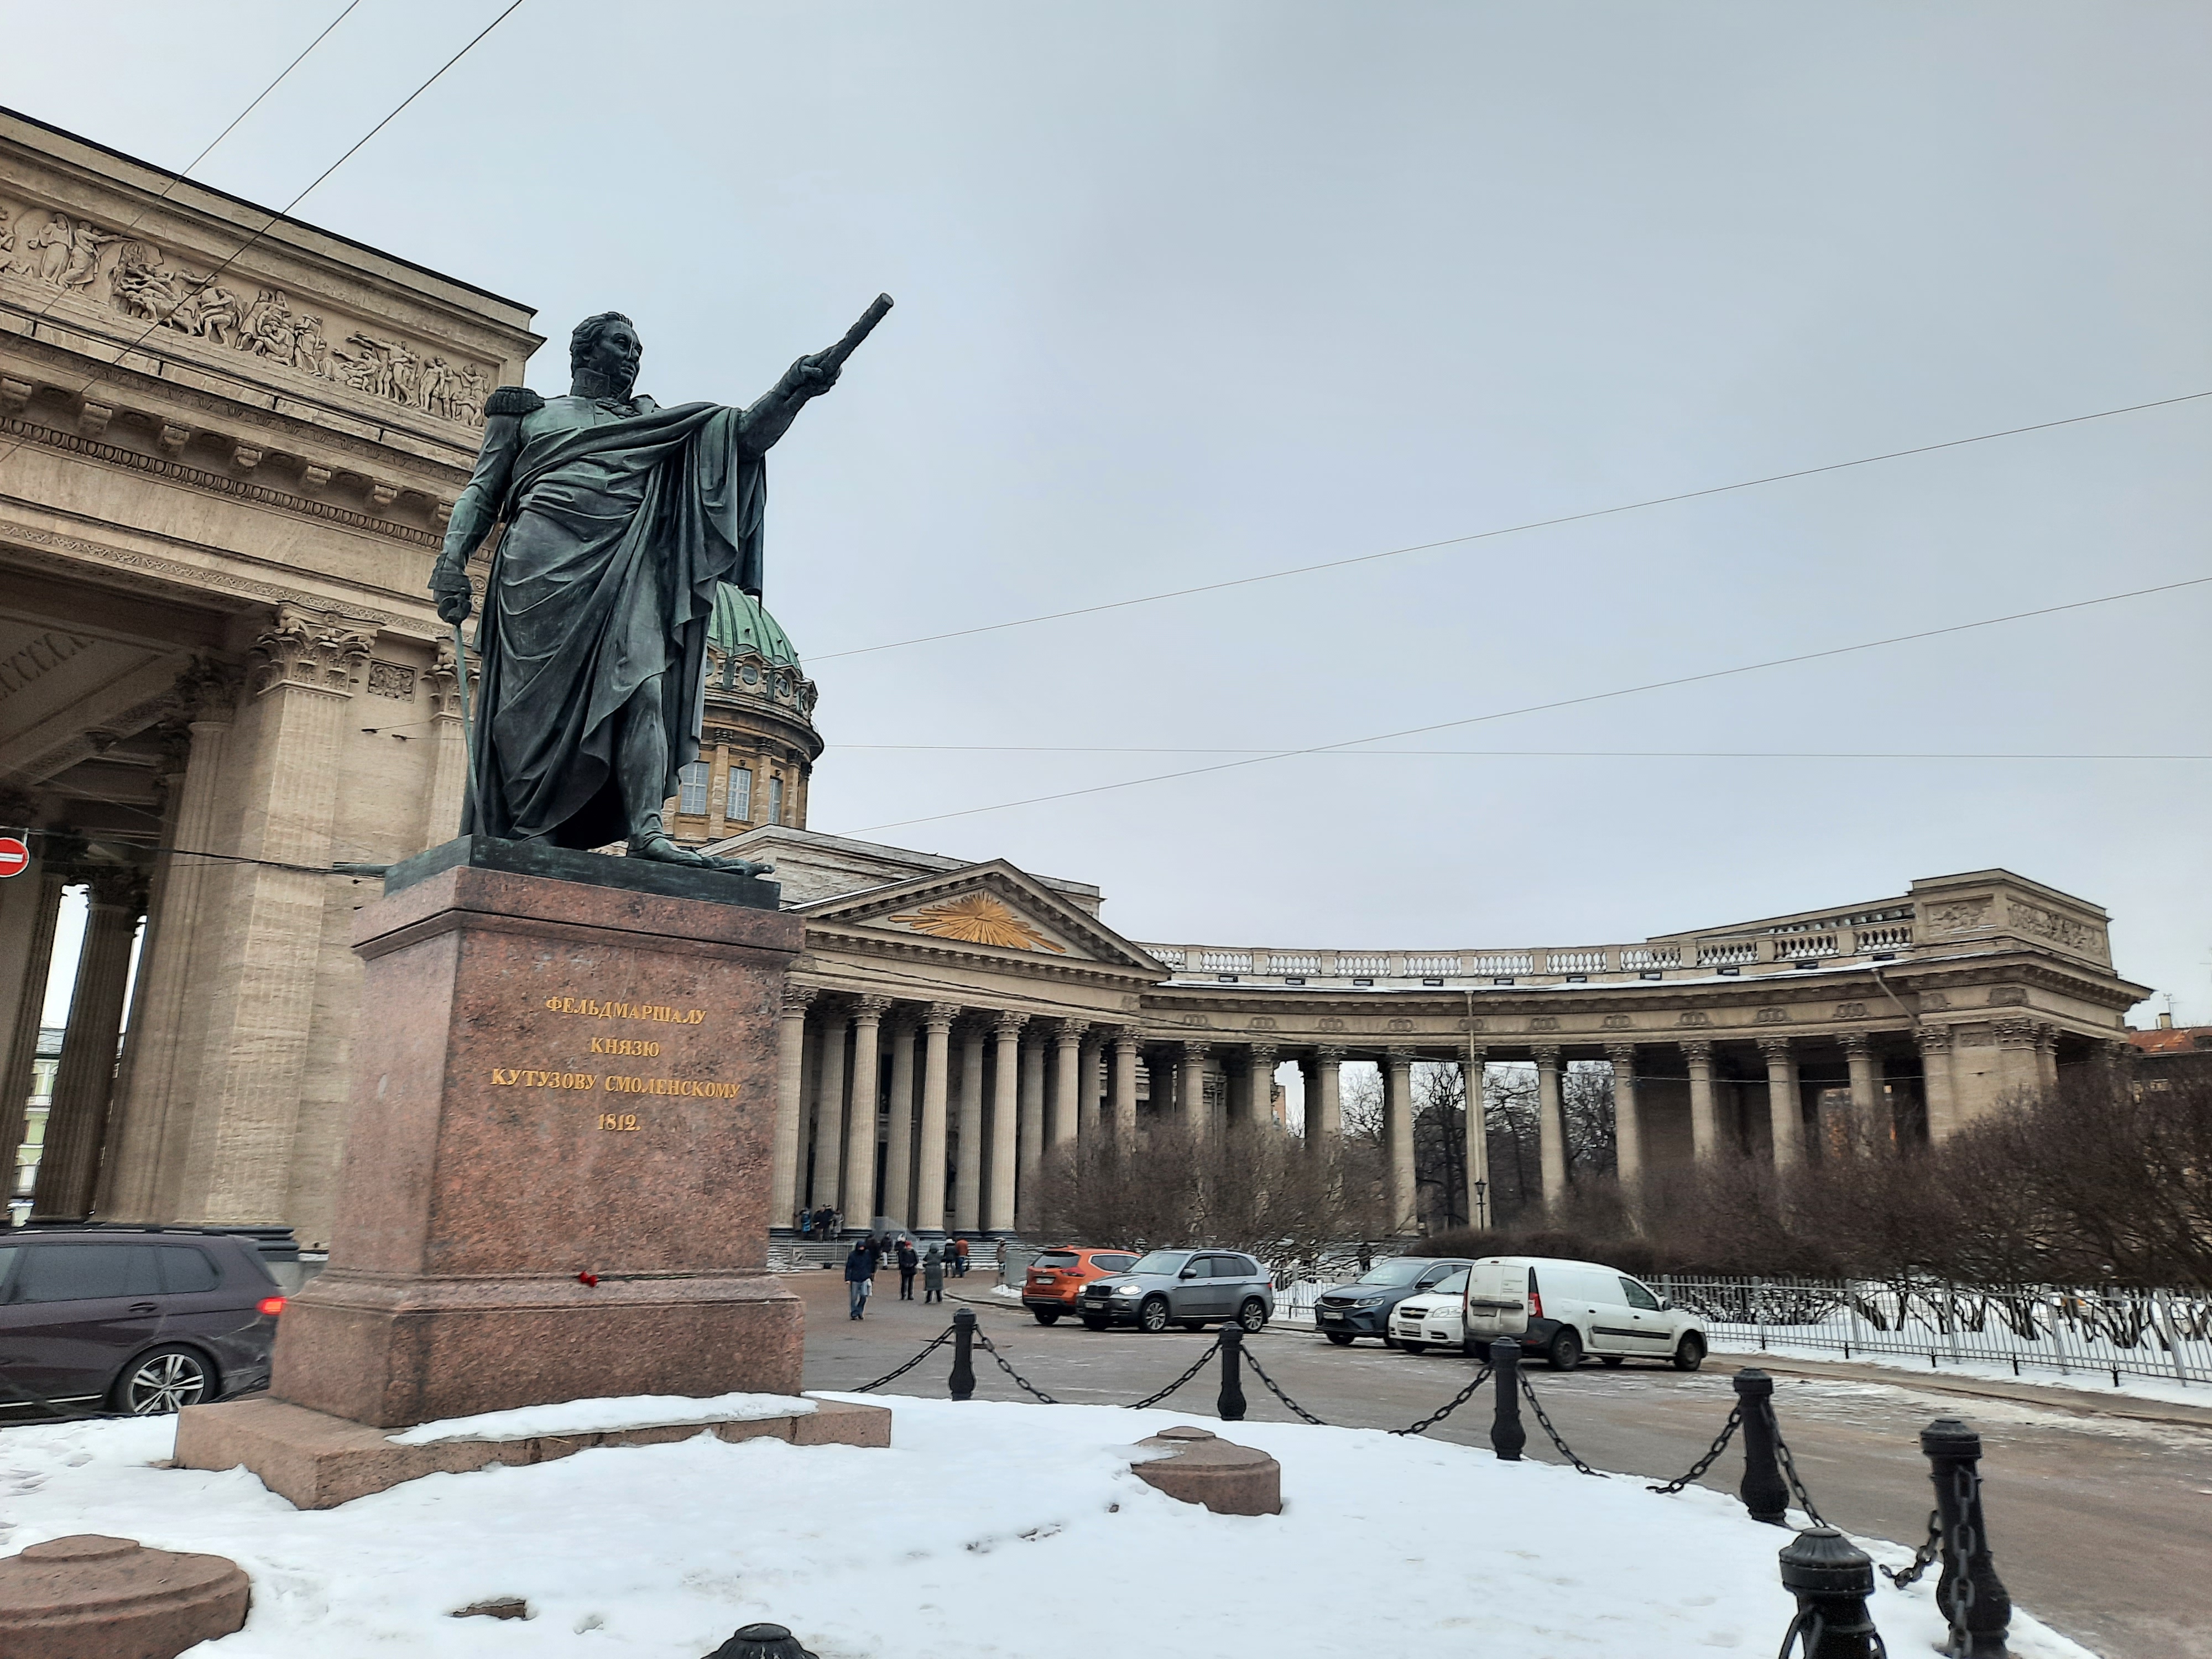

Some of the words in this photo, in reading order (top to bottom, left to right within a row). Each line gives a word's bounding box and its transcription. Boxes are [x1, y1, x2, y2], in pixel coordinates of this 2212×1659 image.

[546, 996, 707, 1024] ФЕЛЬДМАРШАЛУ
[589, 1036, 660, 1057] КНЯЗЮ
[490, 1068, 598, 1090] КУТУЗОВУ
[604, 1075, 741, 1098] СМОЛЕНСКОМУ
[597, 1113, 641, 1131] 1812.
